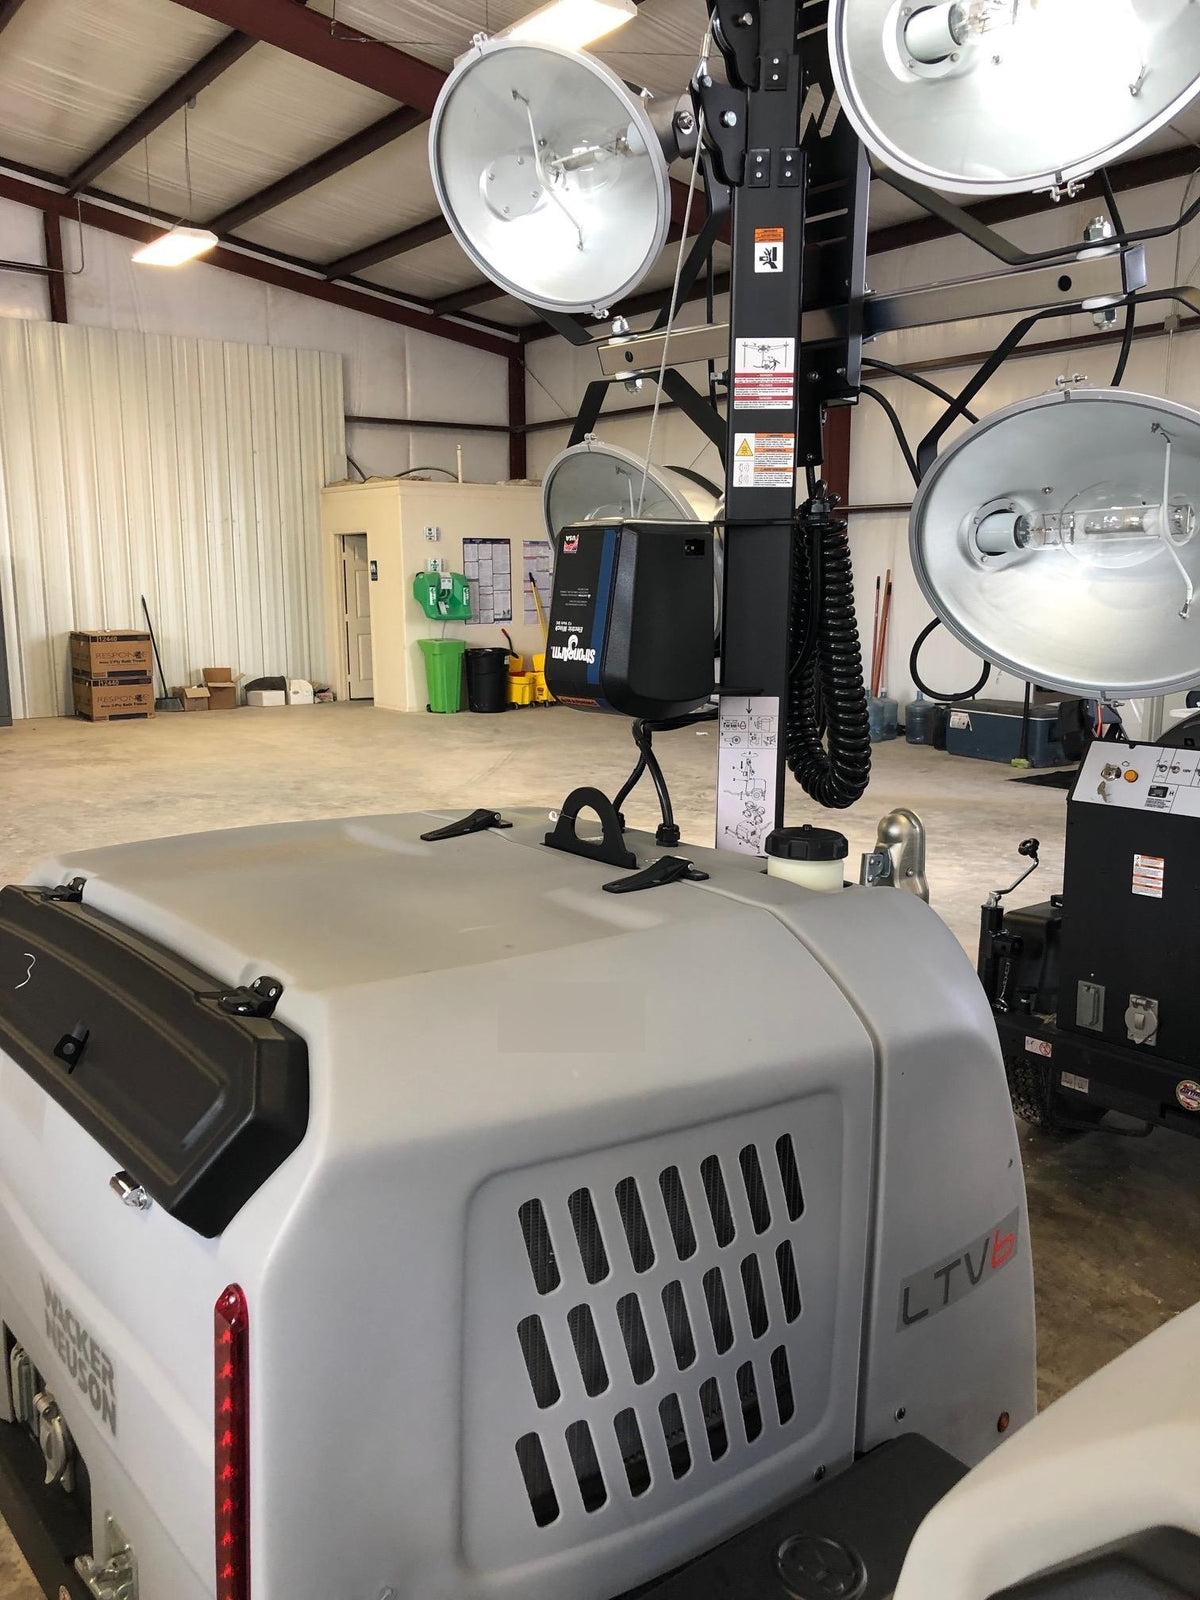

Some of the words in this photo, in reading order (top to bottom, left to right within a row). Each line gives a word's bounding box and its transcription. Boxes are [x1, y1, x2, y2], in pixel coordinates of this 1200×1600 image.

[15, 952, 36, 989] 3
[39, 1271, 116, 1399] WACKER
[44, 1308, 117, 1438] NEUSON
